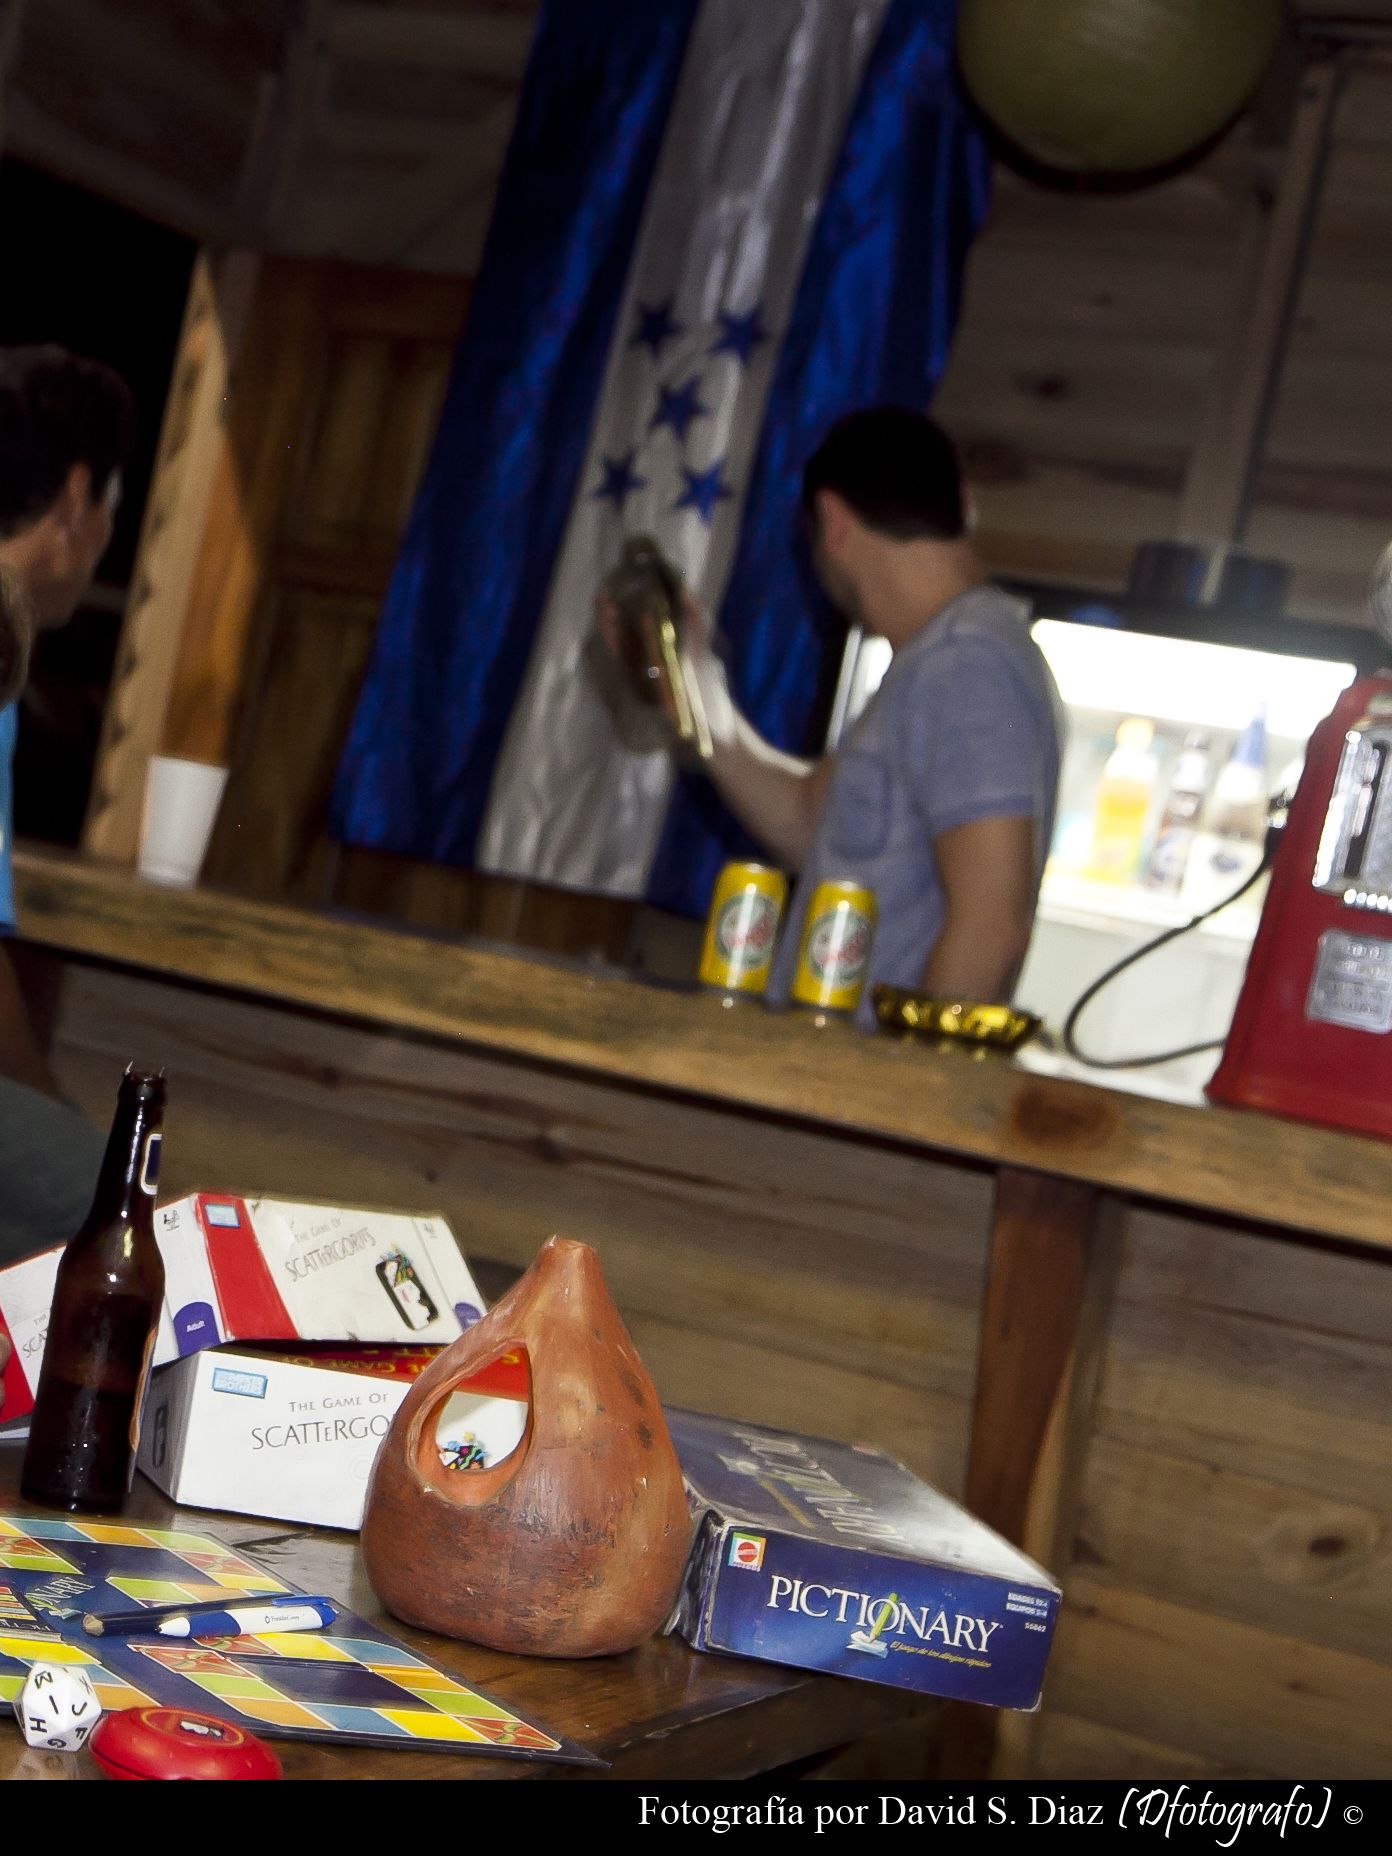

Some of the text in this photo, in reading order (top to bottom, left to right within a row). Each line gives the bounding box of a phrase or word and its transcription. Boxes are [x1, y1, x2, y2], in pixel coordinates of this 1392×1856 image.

[289, 1392, 389, 1413] THE GAME OF
[251, 1413, 391, 1450] SCATTERGO
[766, 1574, 999, 1652] PICTIONARY
[29, 1716, 48, 1733] H
